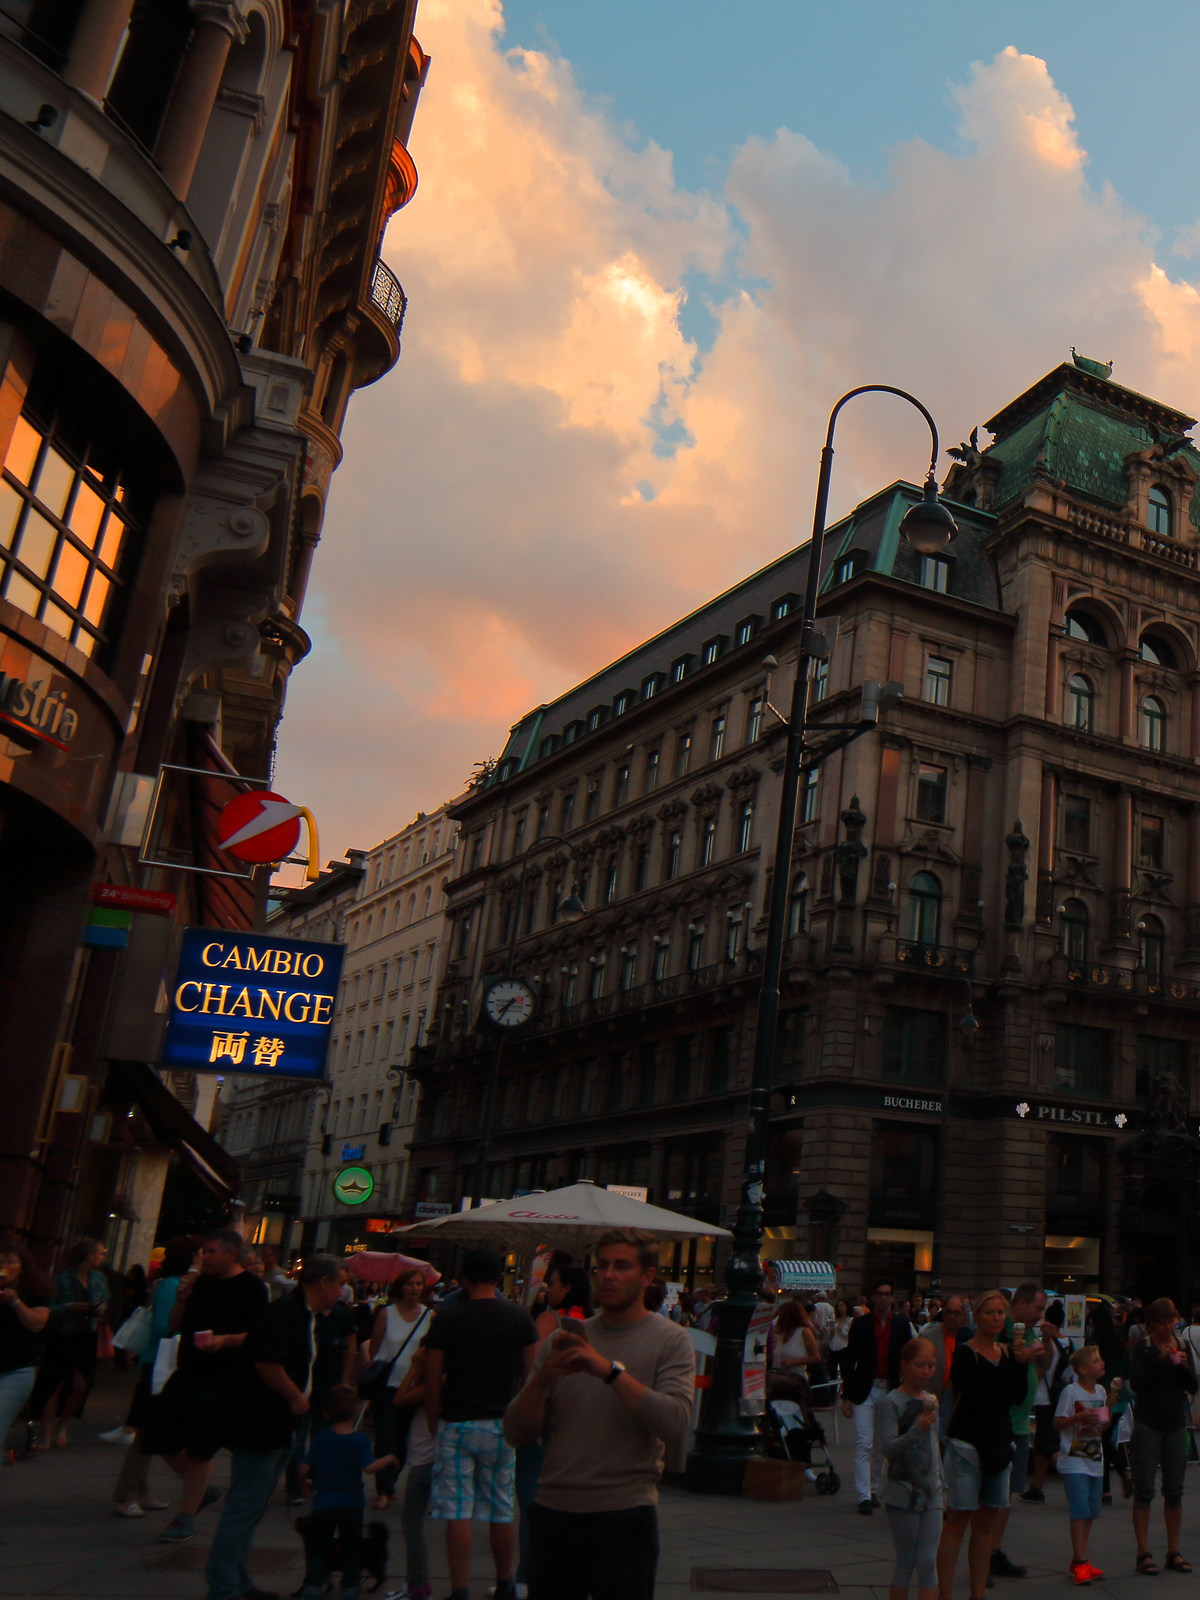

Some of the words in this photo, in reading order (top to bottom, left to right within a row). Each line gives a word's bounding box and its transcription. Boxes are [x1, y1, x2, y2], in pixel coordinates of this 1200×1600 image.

[202, 942, 324, 978] CAMBIO
[175, 980, 334, 1025] CHANGE
[209, 1030, 285, 1067] 両替
[883, 1096, 943, 1112] BUCHERER
[1037, 1105, 1107, 1125] PILSTL
